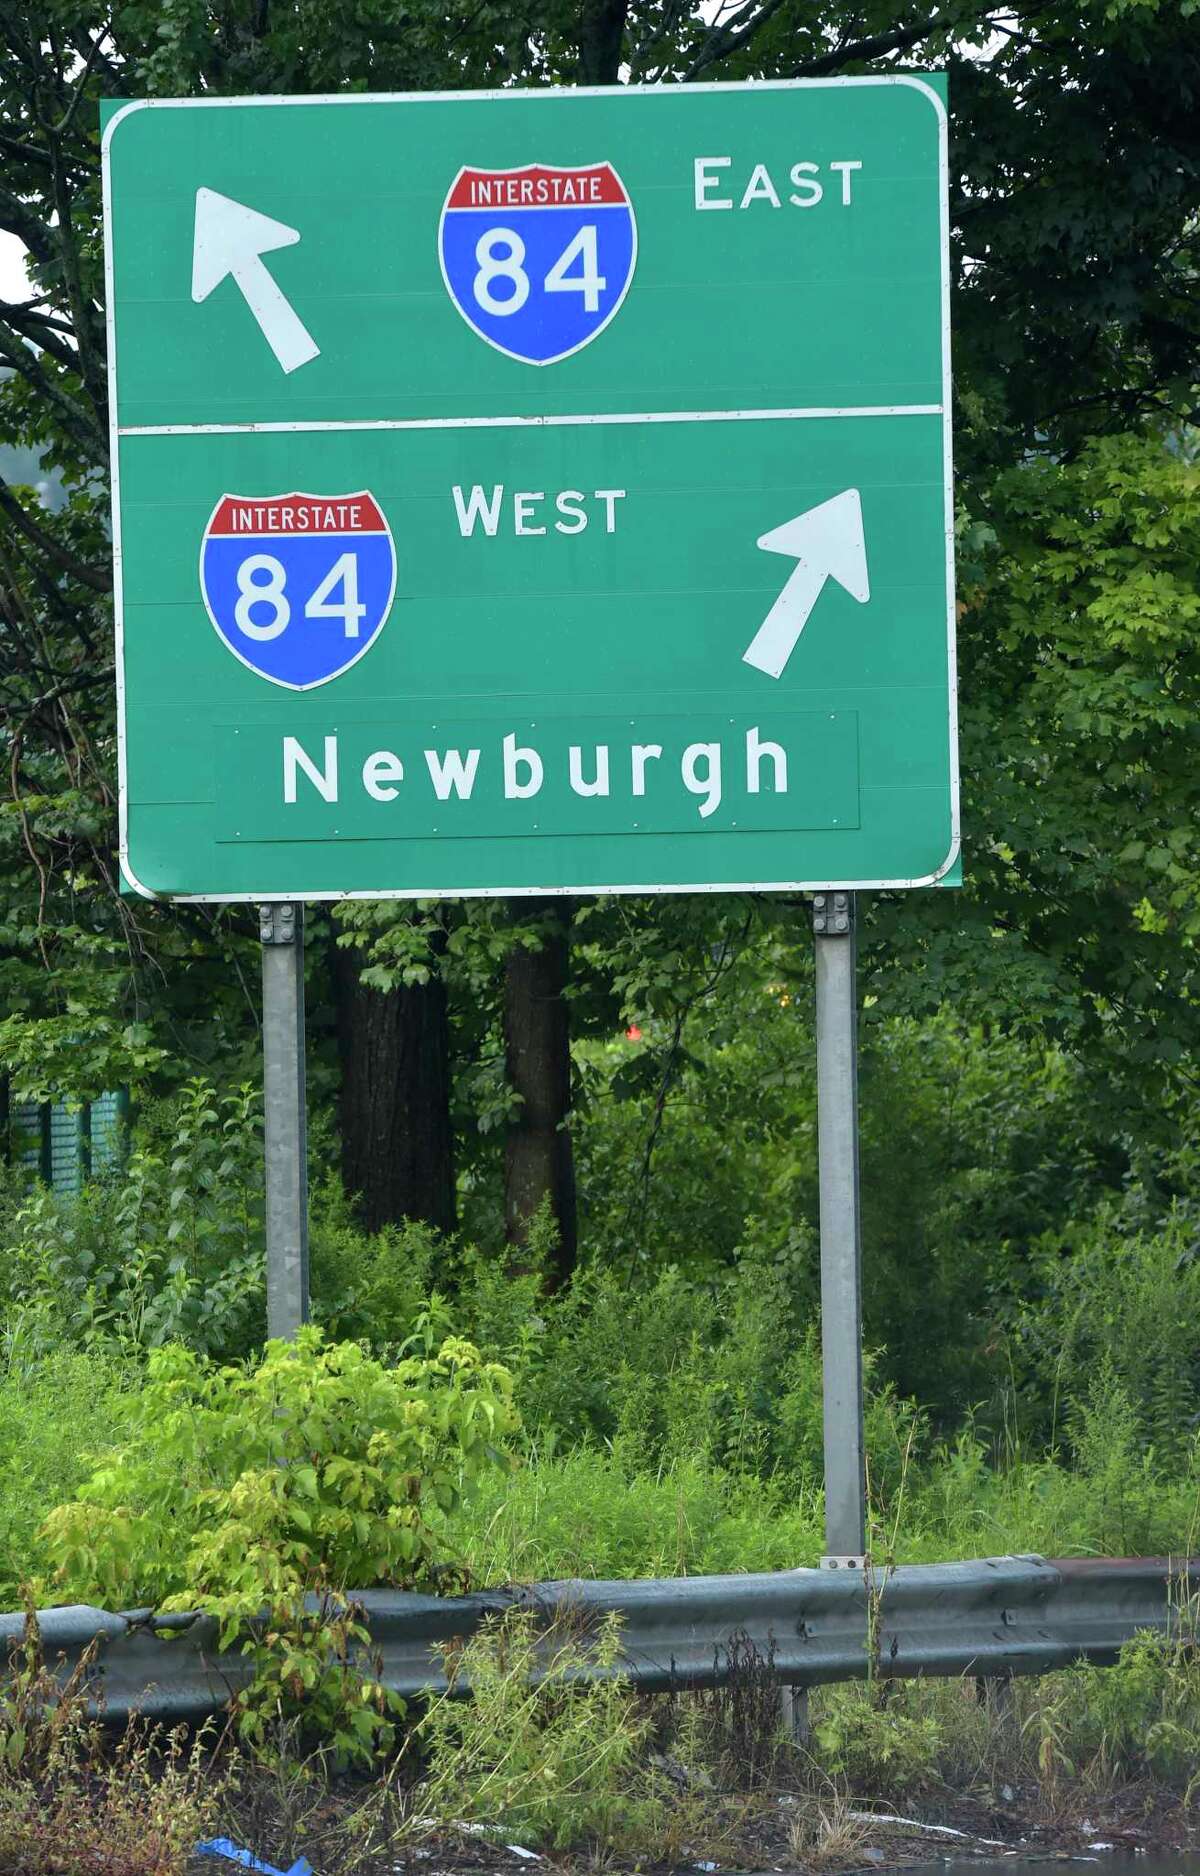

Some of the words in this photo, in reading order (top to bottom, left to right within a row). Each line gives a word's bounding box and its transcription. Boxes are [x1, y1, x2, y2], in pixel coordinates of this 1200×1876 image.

[471, 177, 602, 204] INTERSTATE
[694, 156, 863, 210] EAST
[473, 224, 606, 316] 84
[231, 505, 362, 531] INTERSTATE
[452, 484, 626, 537] WEST
[234, 552, 367, 641] 84
[282, 726, 789, 818] Newburgh
